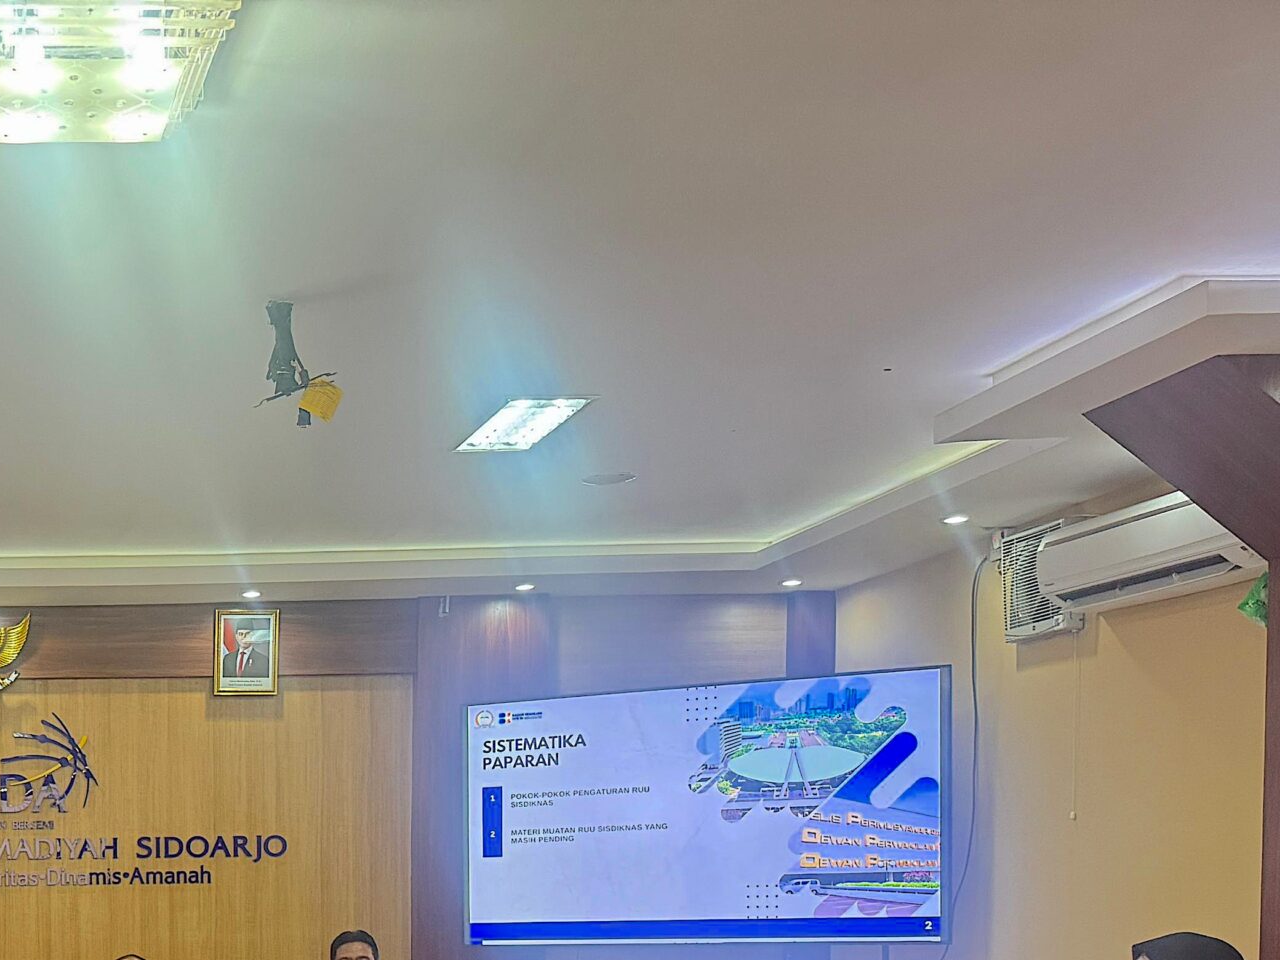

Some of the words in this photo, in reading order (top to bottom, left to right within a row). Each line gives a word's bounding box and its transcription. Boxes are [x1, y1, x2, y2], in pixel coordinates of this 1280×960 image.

[482, 734, 587, 754] SISTEMATIKA
[482, 752, 559, 770] PAPARAN
[490, 794, 496, 802] 1
[510, 790, 571, 800] POKOK-POKOK
[573, 787, 630, 797] PENGATURAN
[631, 786, 650, 794] RUU
[510, 800, 554, 809] SISDIKNAS
[12, 820, 54, 831] BERSEMI
[510, 828, 541, 837] MATERI
[542, 826, 576, 835] MUATAN
[577, 825, 596, 833] RUU
[597, 824, 643, 833] SISDIKNAS
[644, 823, 668, 831] YANG
[490, 830, 496, 838] 2
[510, 836, 537, 844] MASIH
[538, 835, 575, 843] PENDING
[135, 834, 288, 863] SIDOARJO
[924, 920, 933, 930] 2
